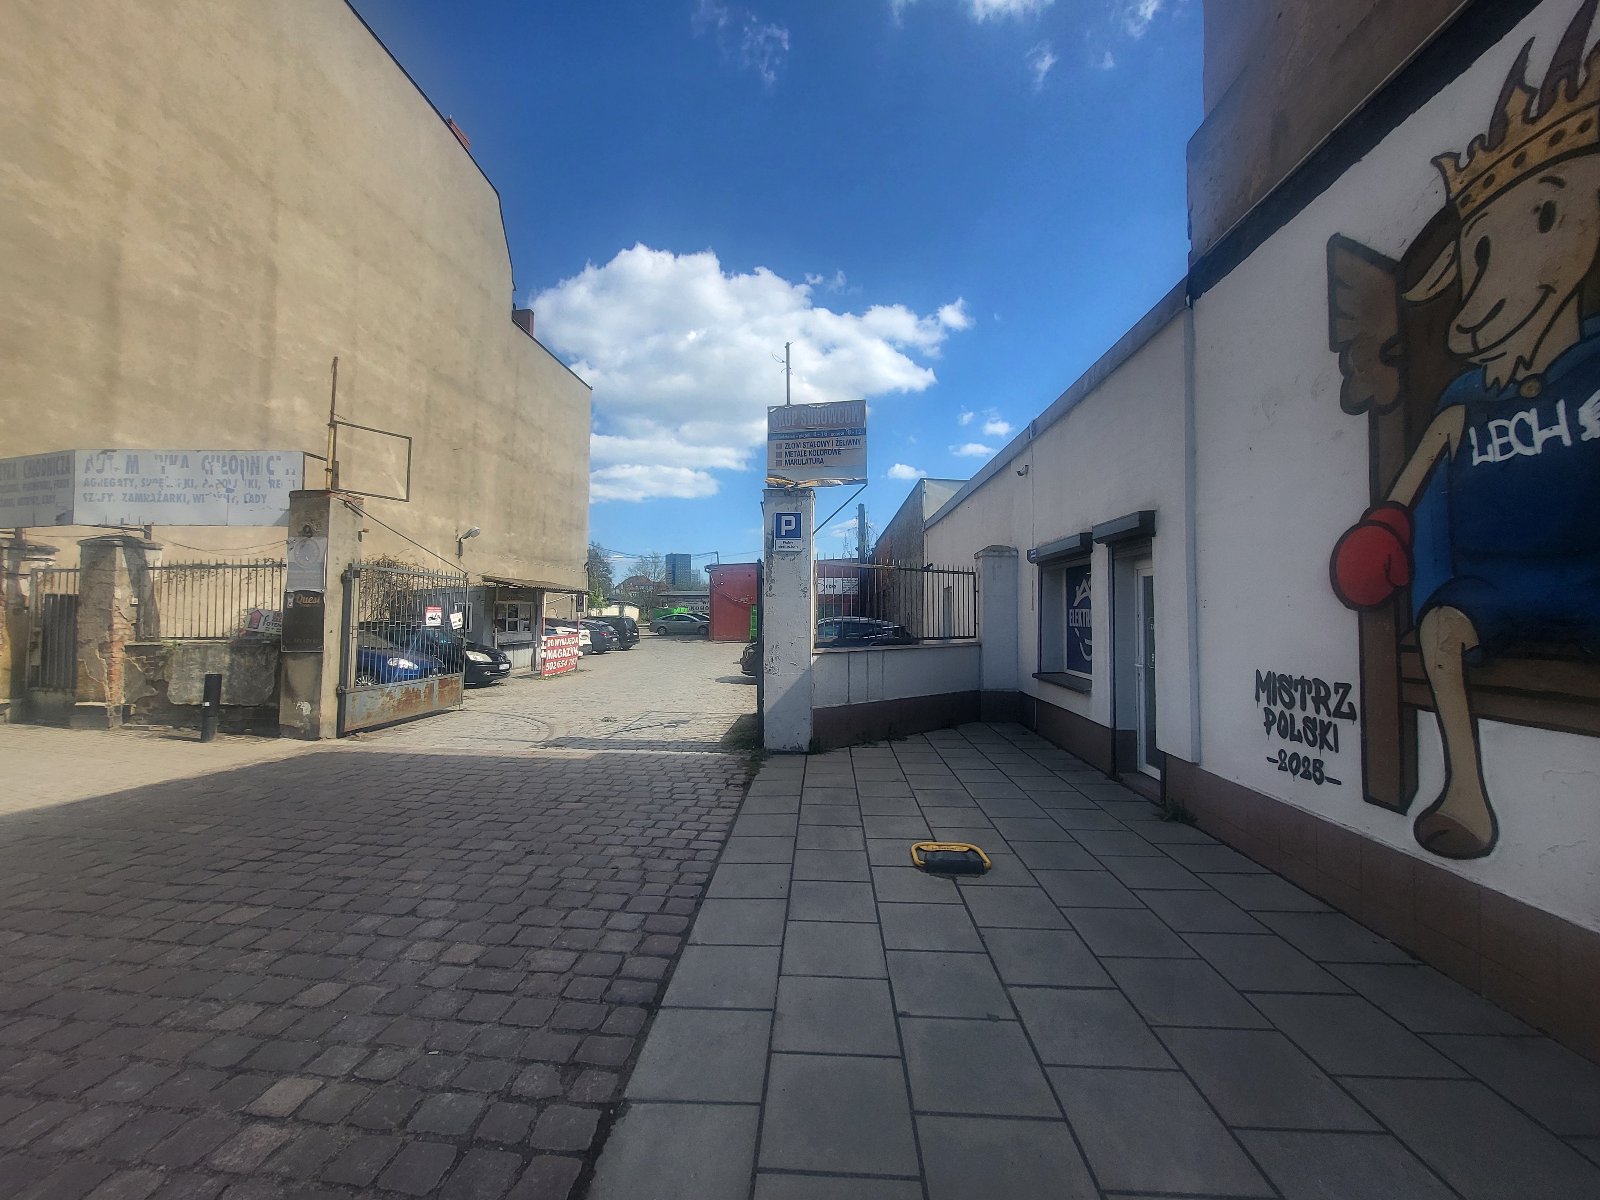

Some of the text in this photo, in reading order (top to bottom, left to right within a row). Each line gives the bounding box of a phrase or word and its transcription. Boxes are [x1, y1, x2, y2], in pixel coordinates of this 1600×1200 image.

[1468, 398, 1573, 467] LECH
[784, 451, 807, 459] METALE
[784, 457, 825, 467] MAKULATURA
[781, 516, 796, 536] P
[547, 646, 579, 660] MAGAZYN
[1255, 668, 1358, 723] MISTRZ
[1263, 706, 1340, 755] POLSKI
